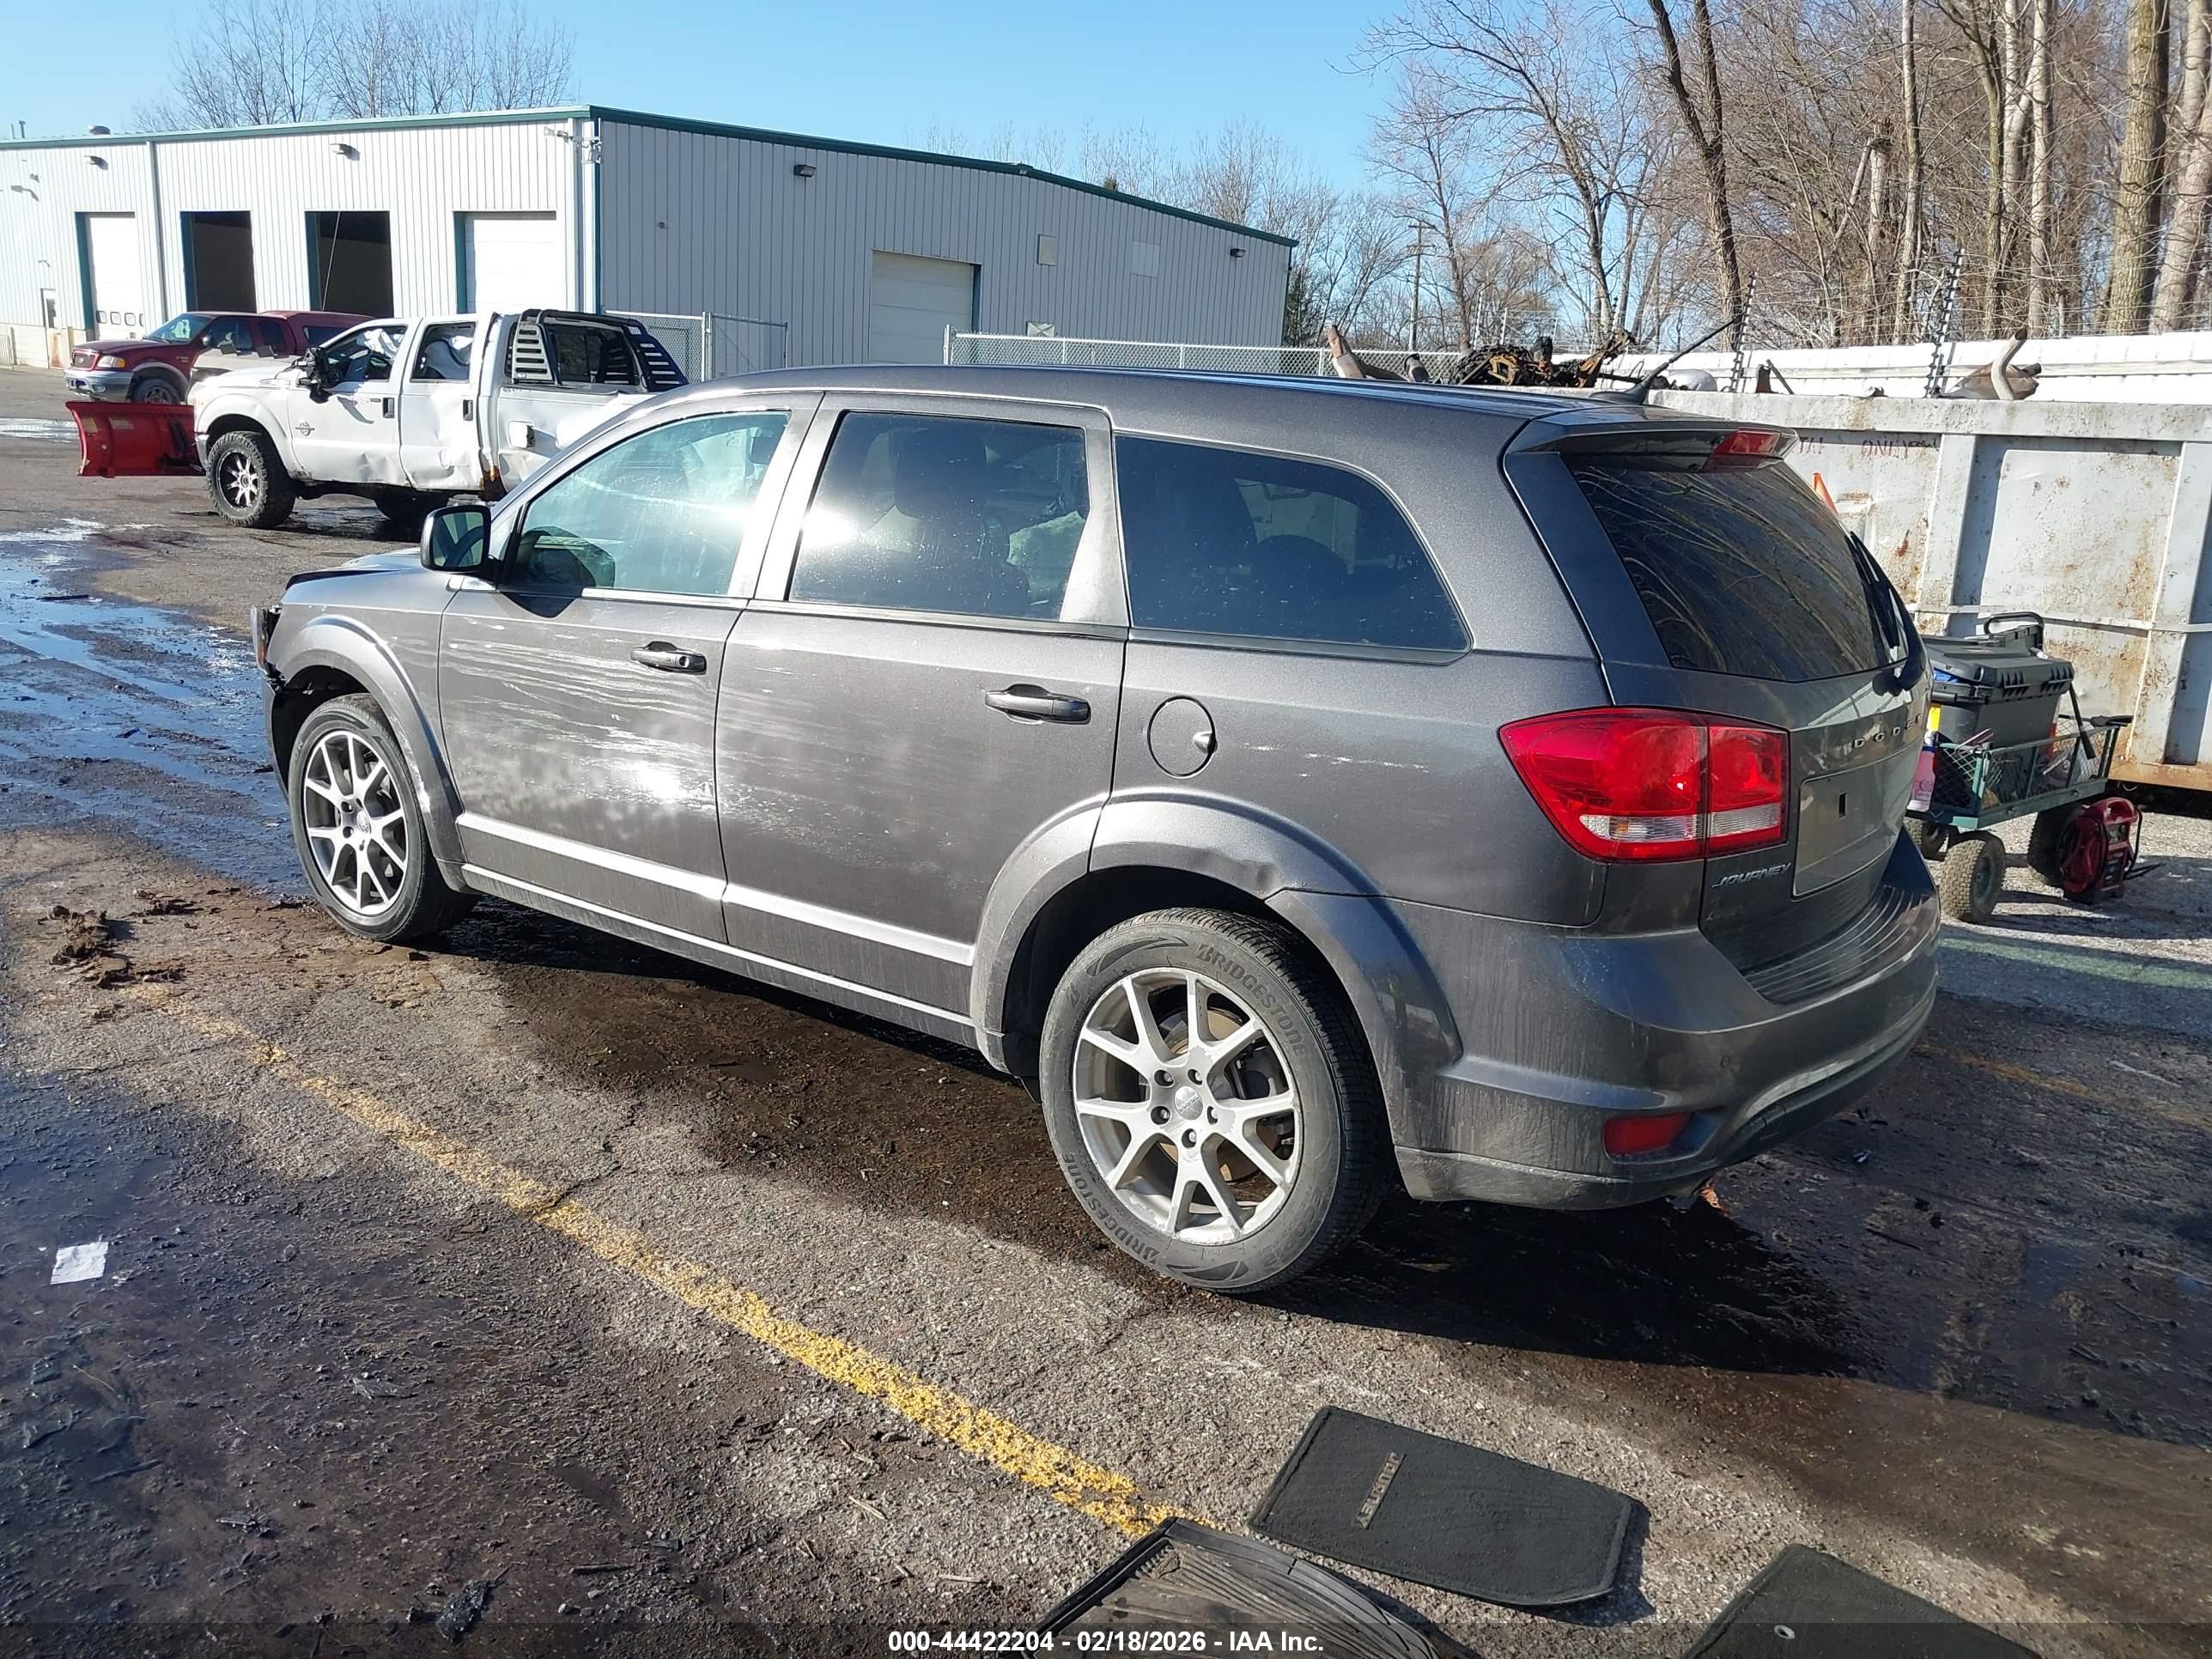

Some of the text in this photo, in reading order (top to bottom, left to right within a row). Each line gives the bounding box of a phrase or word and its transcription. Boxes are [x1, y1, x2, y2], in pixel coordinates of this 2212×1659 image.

[1711, 861, 1792, 889] JOURNEY
[1194, 943, 1306, 1058] BRIDGESTONE
[1061, 1152, 1161, 1266] BRIDGESTONE
